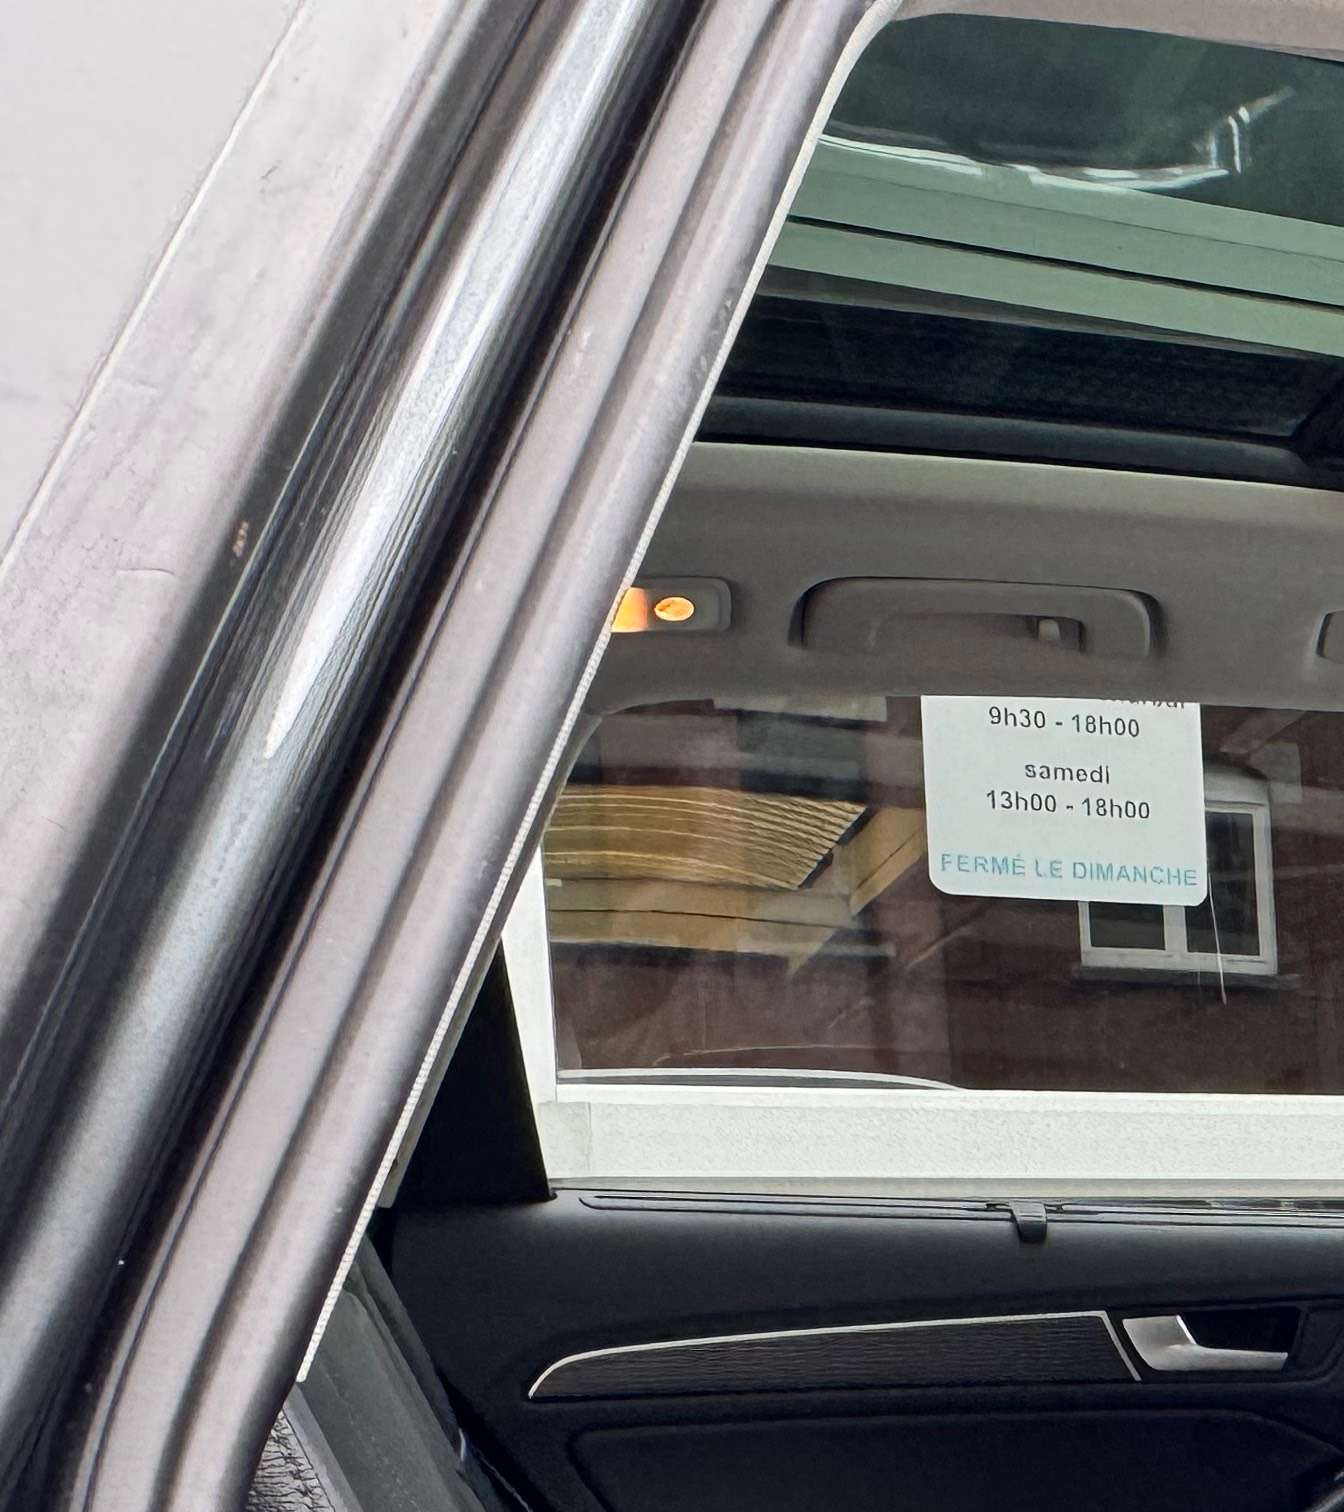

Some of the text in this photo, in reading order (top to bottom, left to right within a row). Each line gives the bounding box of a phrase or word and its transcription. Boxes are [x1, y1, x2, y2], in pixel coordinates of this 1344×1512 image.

[989, 705, 1046, 729] 9h30
[1072, 715, 1141, 738] 18h00
[1024, 763, 1110, 785] samedi
[986, 789, 1057, 813] 13h00
[1082, 798, 1151, 820] 18h00
[940, 853, 1199, 887] FERMÉ LE DIMANCHE
